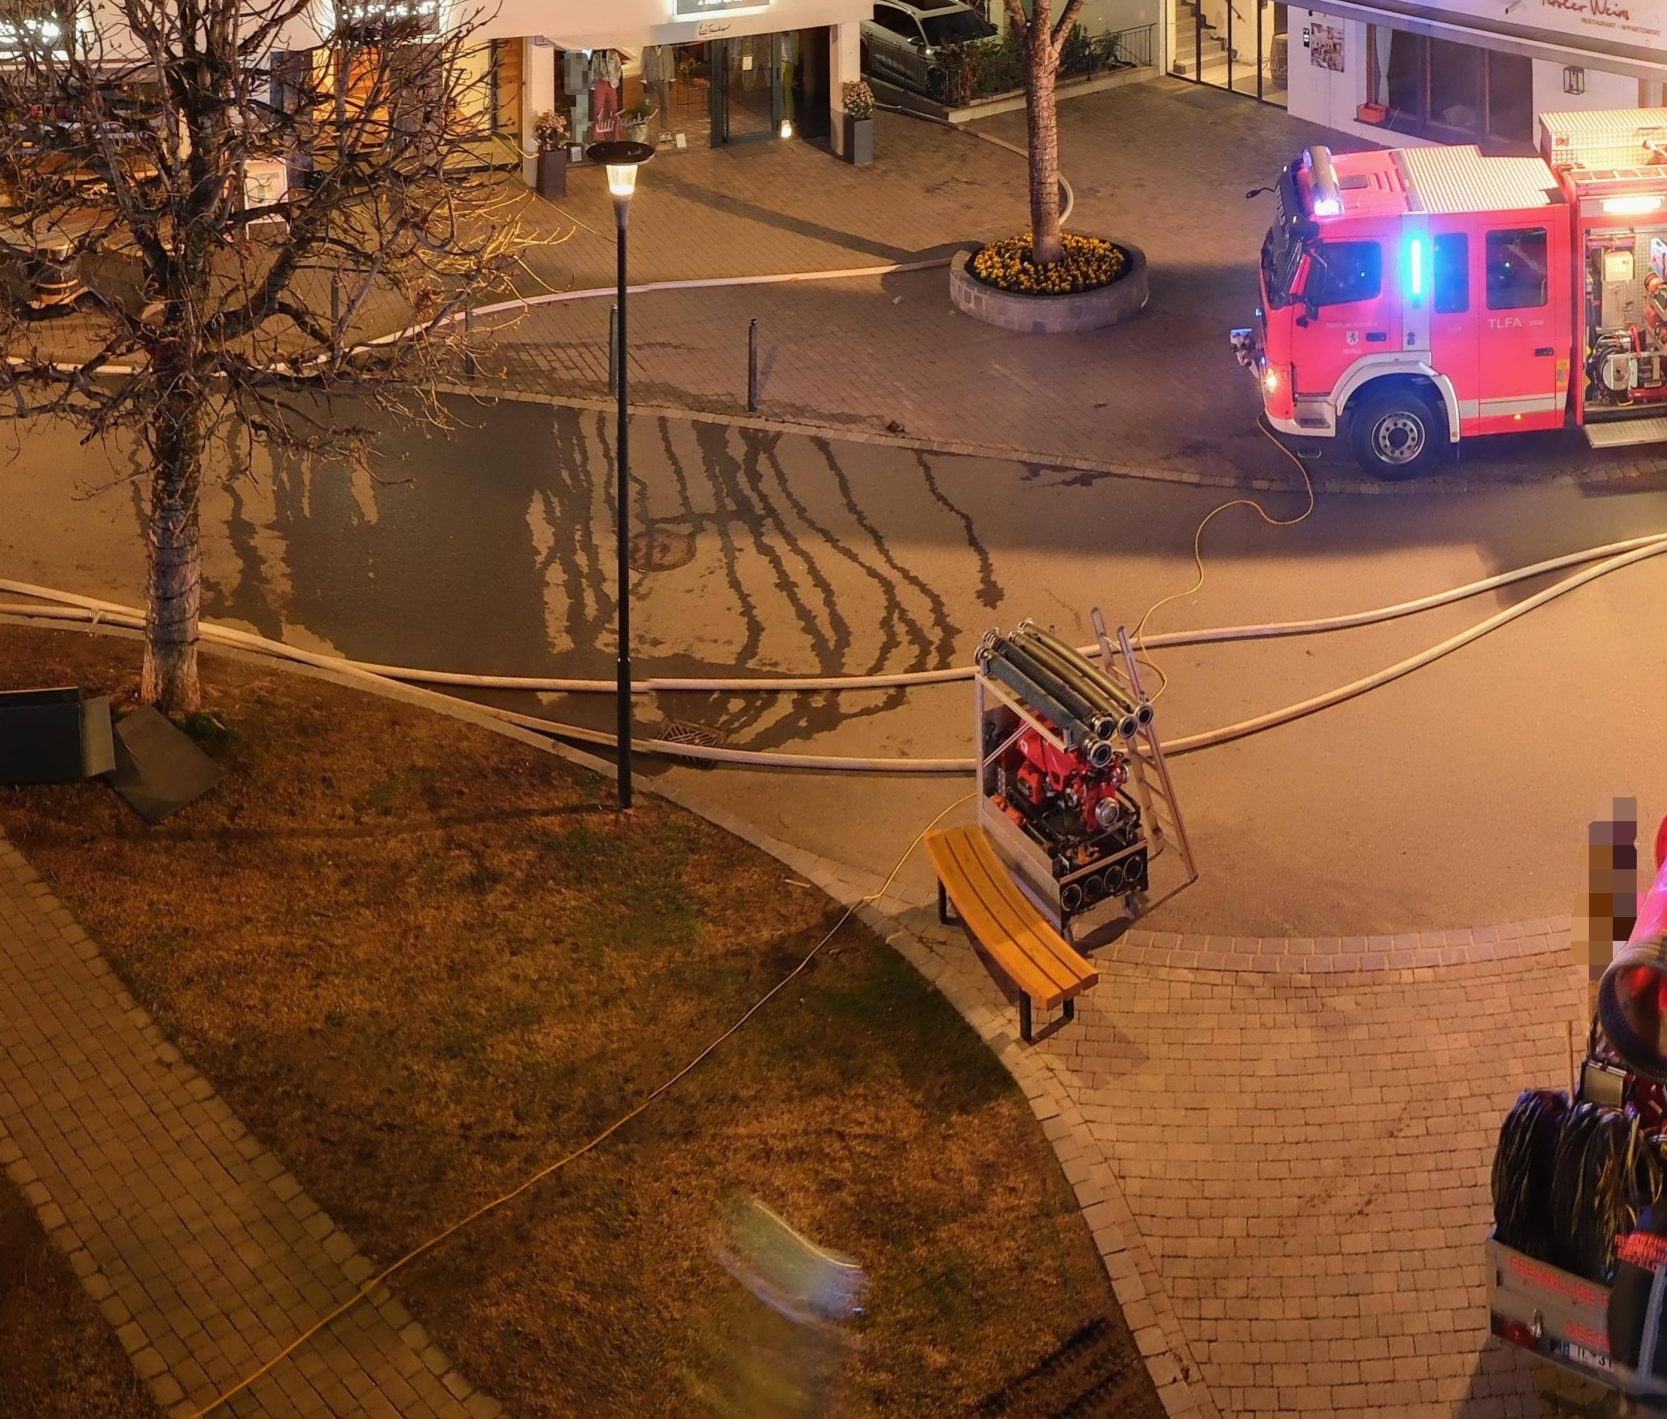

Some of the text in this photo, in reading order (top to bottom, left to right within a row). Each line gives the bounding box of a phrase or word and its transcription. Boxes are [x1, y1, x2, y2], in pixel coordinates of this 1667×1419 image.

[1581, 17, 1617, 29] RESTAURANT
[1488, 318, 1522, 329] TLFA
[1565, 1320, 1610, 1353] SEEF
